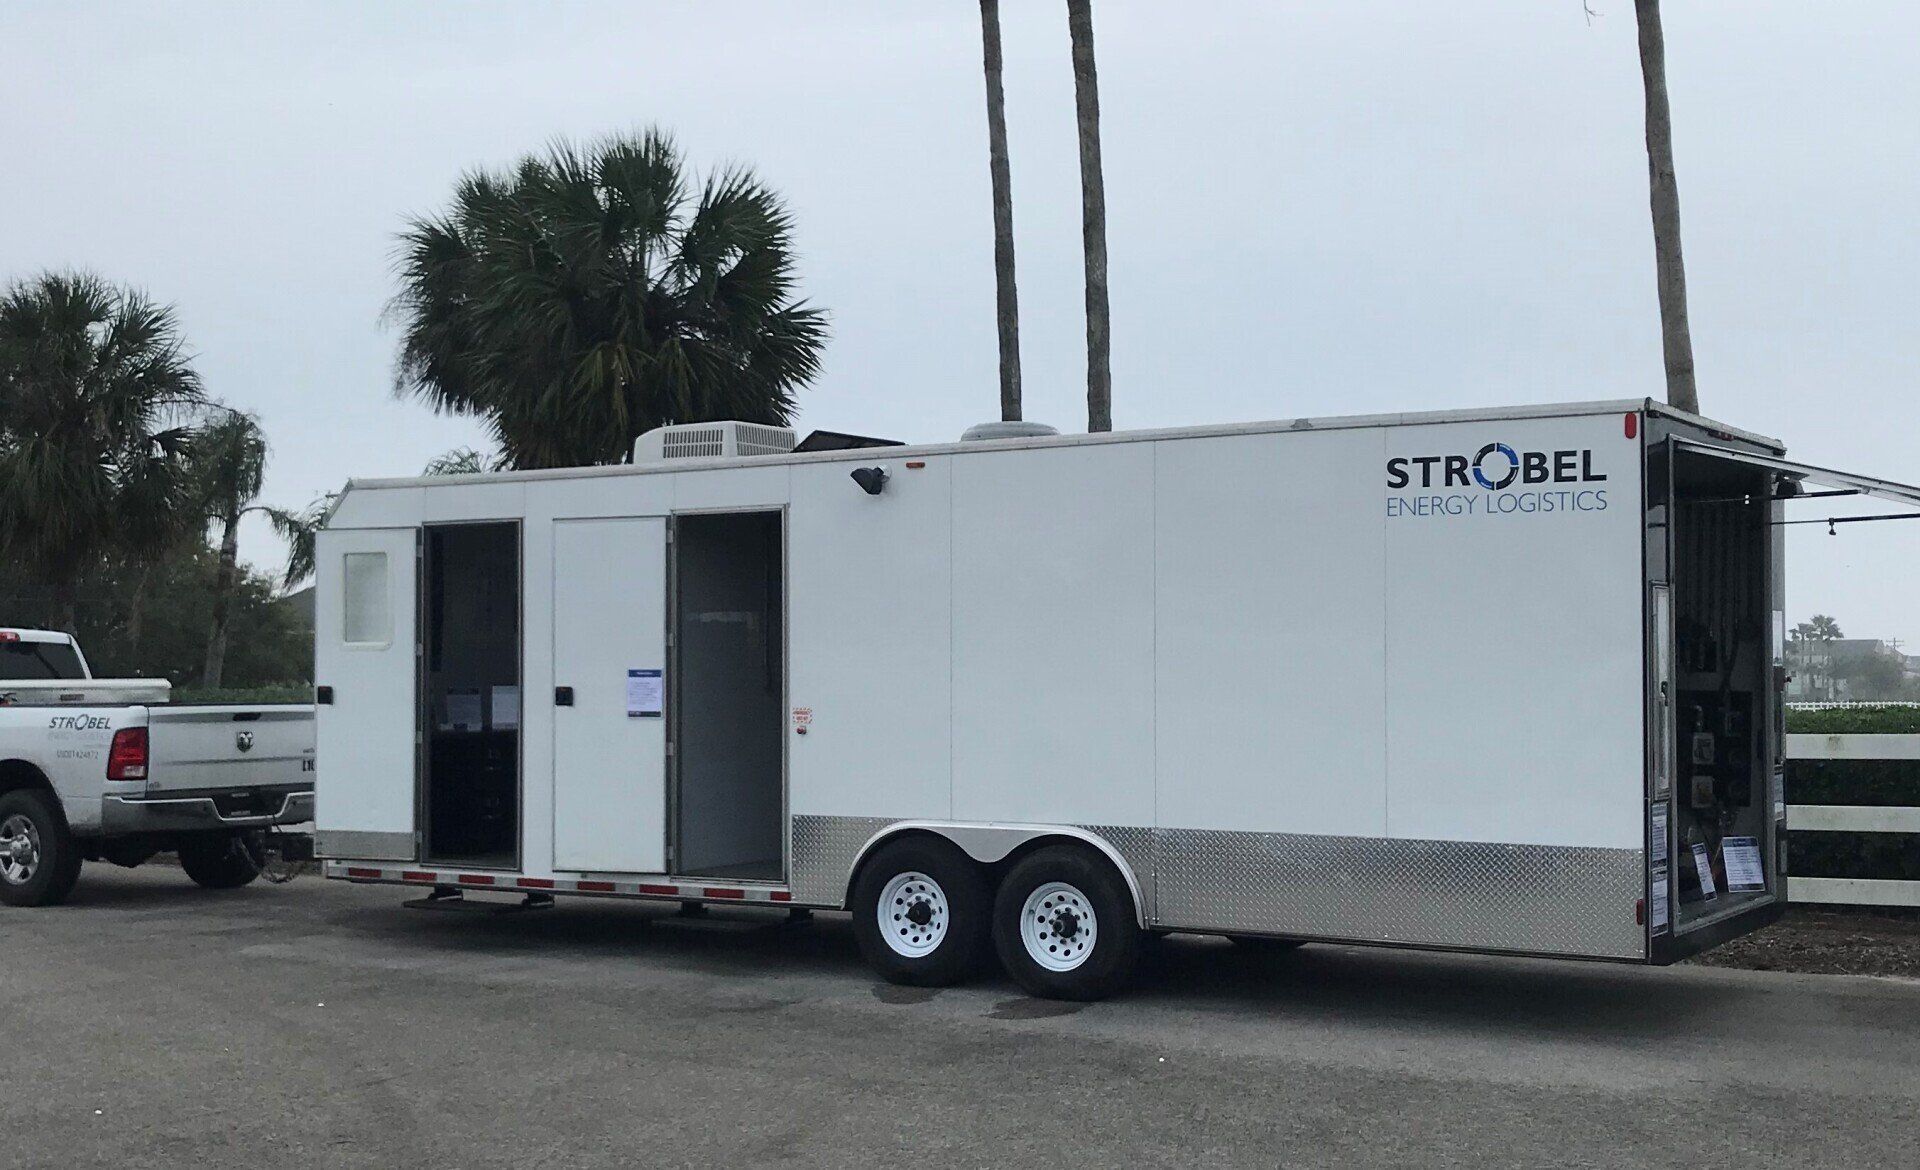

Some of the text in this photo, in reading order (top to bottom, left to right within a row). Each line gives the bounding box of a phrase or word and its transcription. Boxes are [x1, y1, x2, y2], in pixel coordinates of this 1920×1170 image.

[1386, 442, 1607, 491] STROBEL
[1387, 490, 1608, 517] ENERGY LOGISTICS
[49, 713, 111, 731] STROBEL
